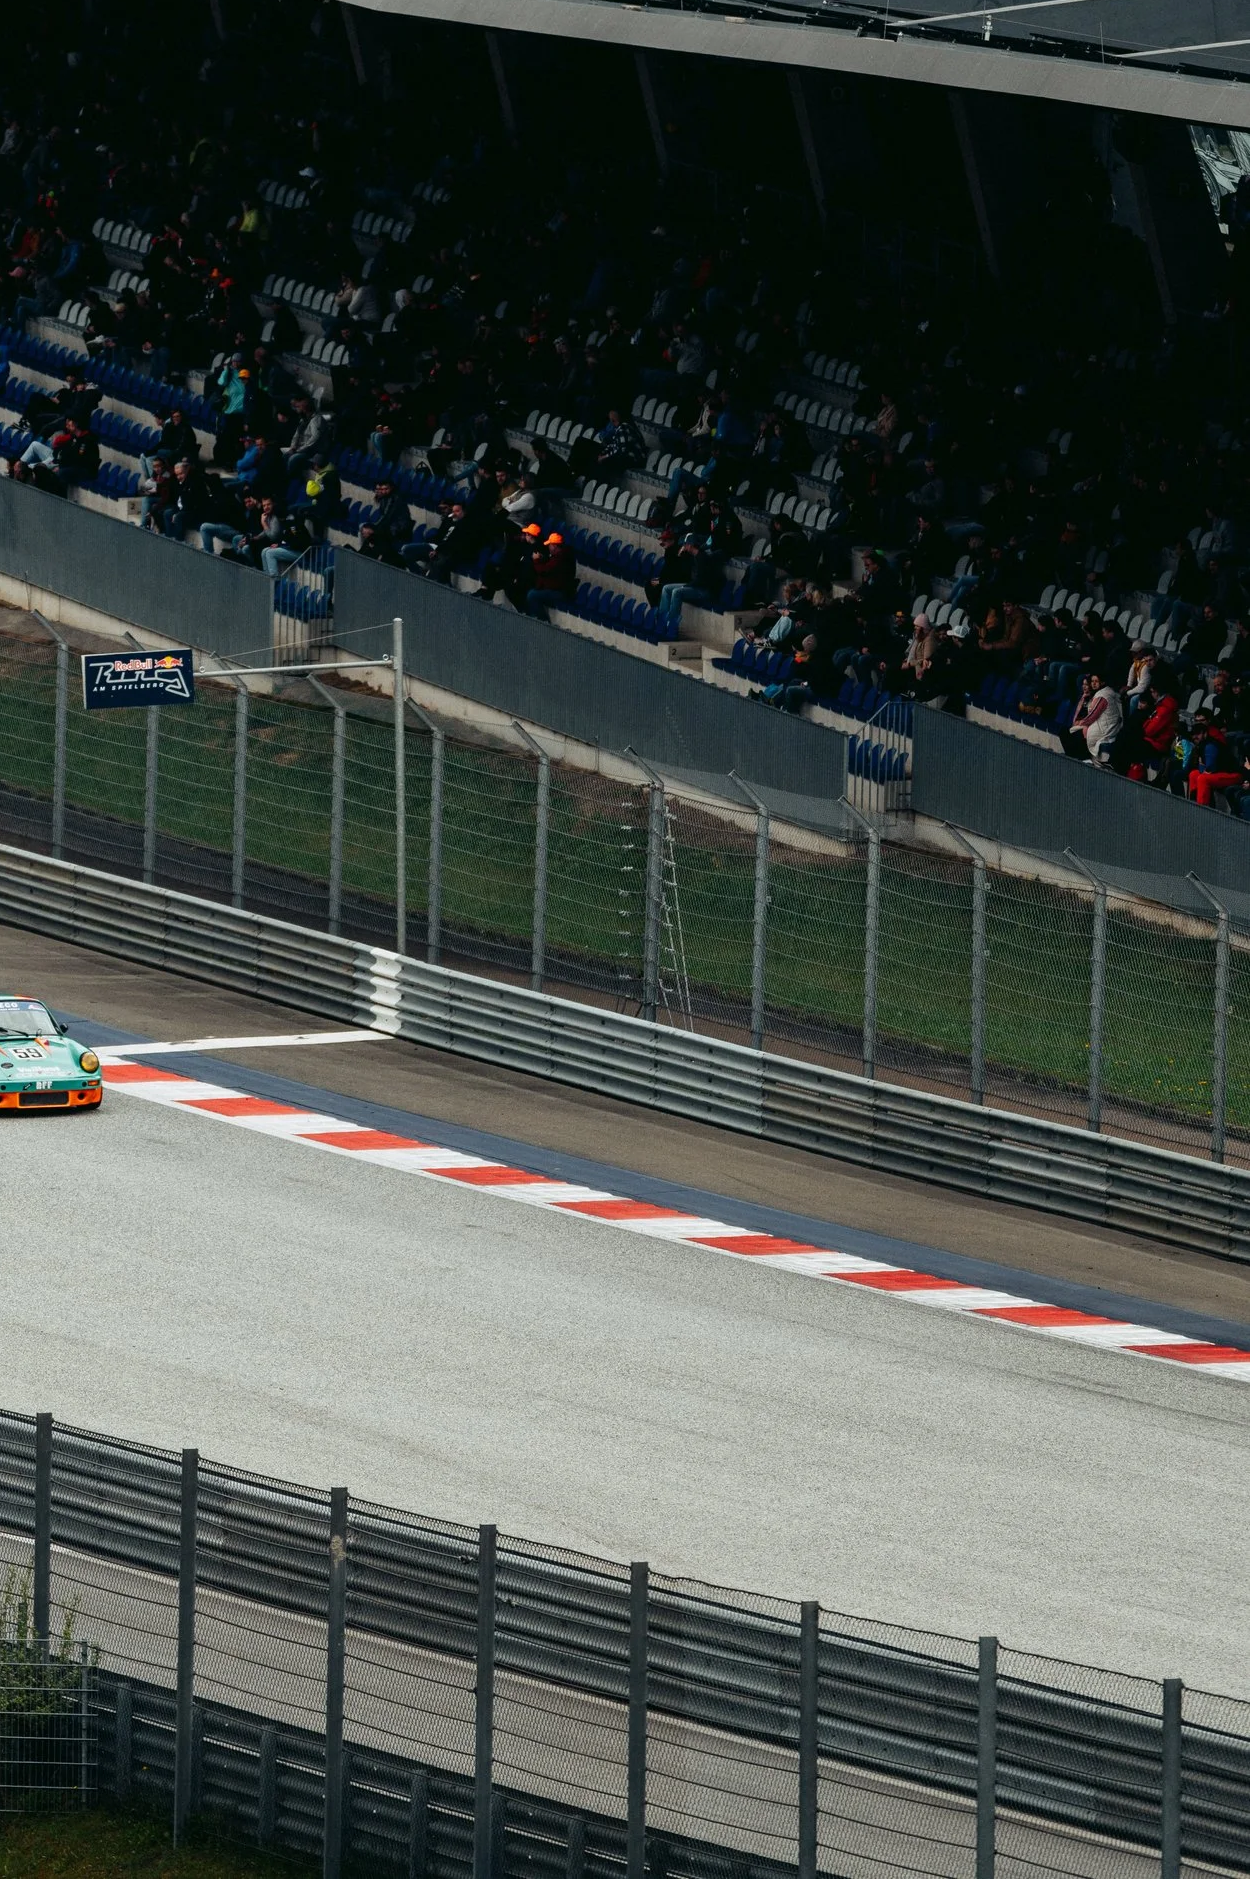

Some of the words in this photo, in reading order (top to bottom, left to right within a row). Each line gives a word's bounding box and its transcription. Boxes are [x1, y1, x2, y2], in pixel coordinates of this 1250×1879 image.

[115, 659, 133, 672] Red
[133, 658, 152, 671] Bull
[111, 682, 164, 691] SPIELBERG
[13, 1048, 43, 1059] 59
